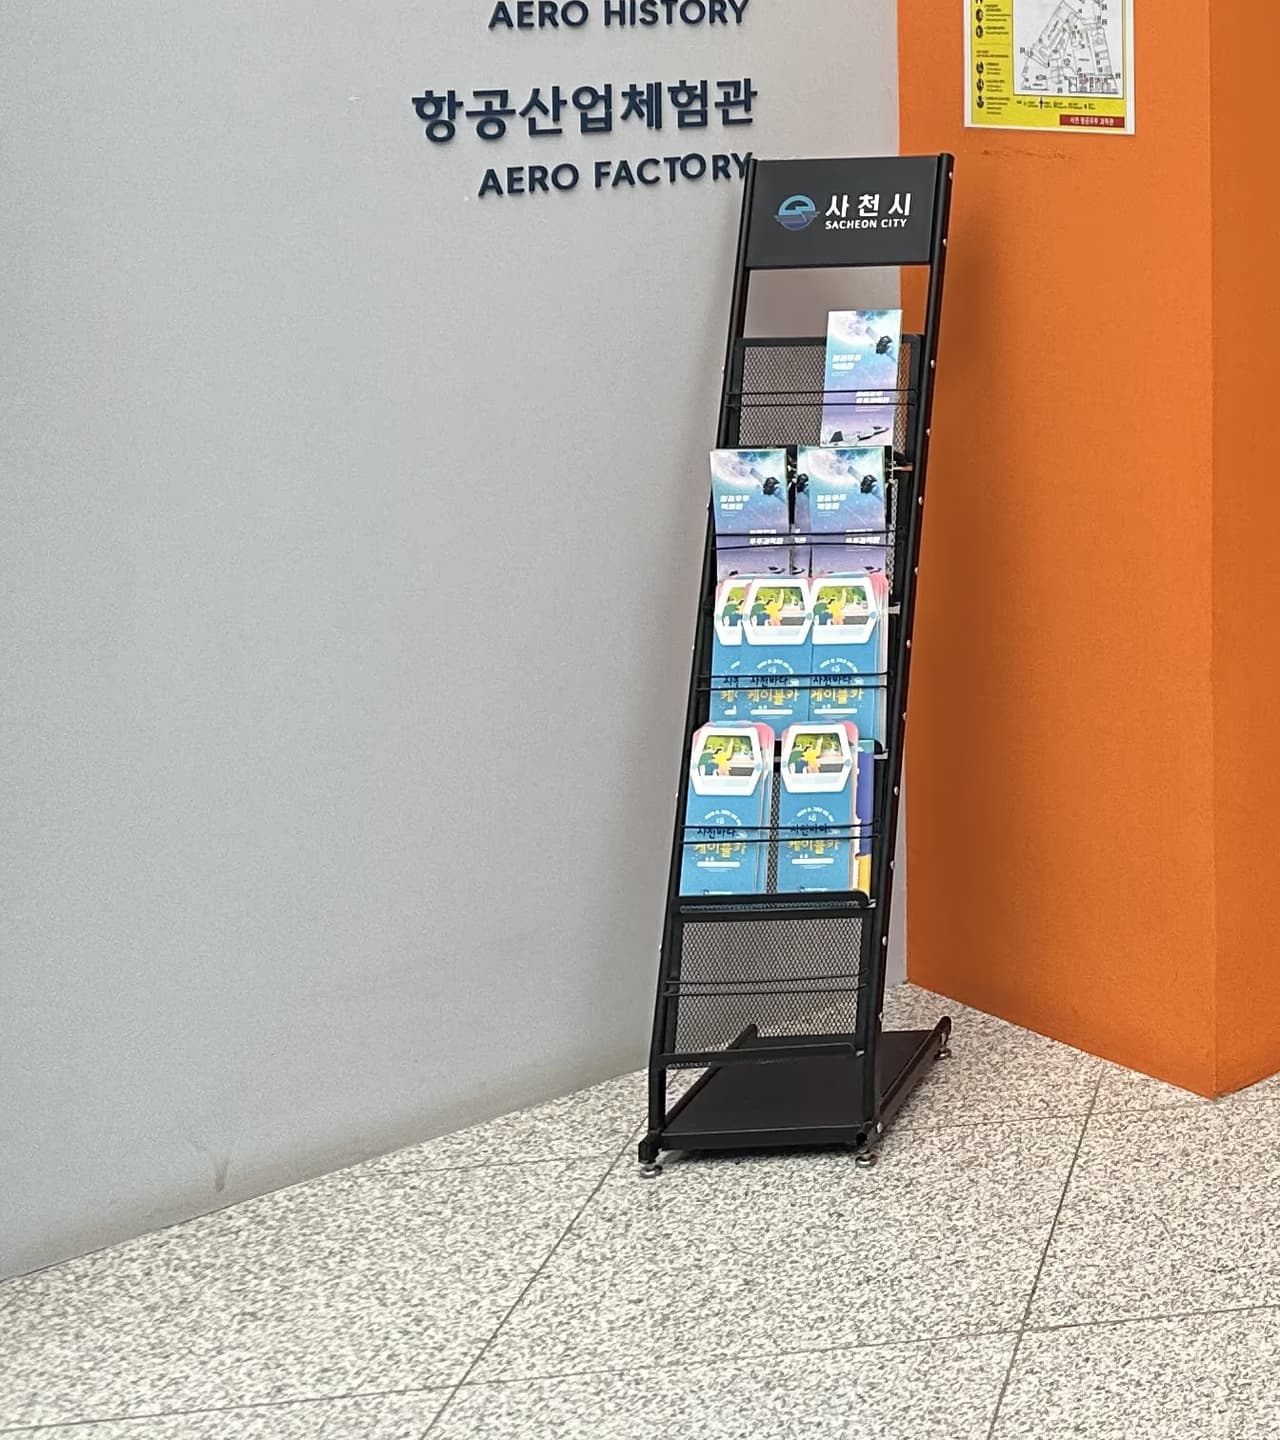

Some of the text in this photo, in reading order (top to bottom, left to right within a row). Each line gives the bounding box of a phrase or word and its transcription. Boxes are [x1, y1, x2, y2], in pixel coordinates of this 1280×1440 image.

[488, 0, 589, 29] AERO
[411, 78, 758, 144] 항공산업체험관
[478, 152, 753, 198] AERO FACTORY
[825, 193, 911, 218] 사천시
[825, 218, 907, 230] SACHEON CITY
